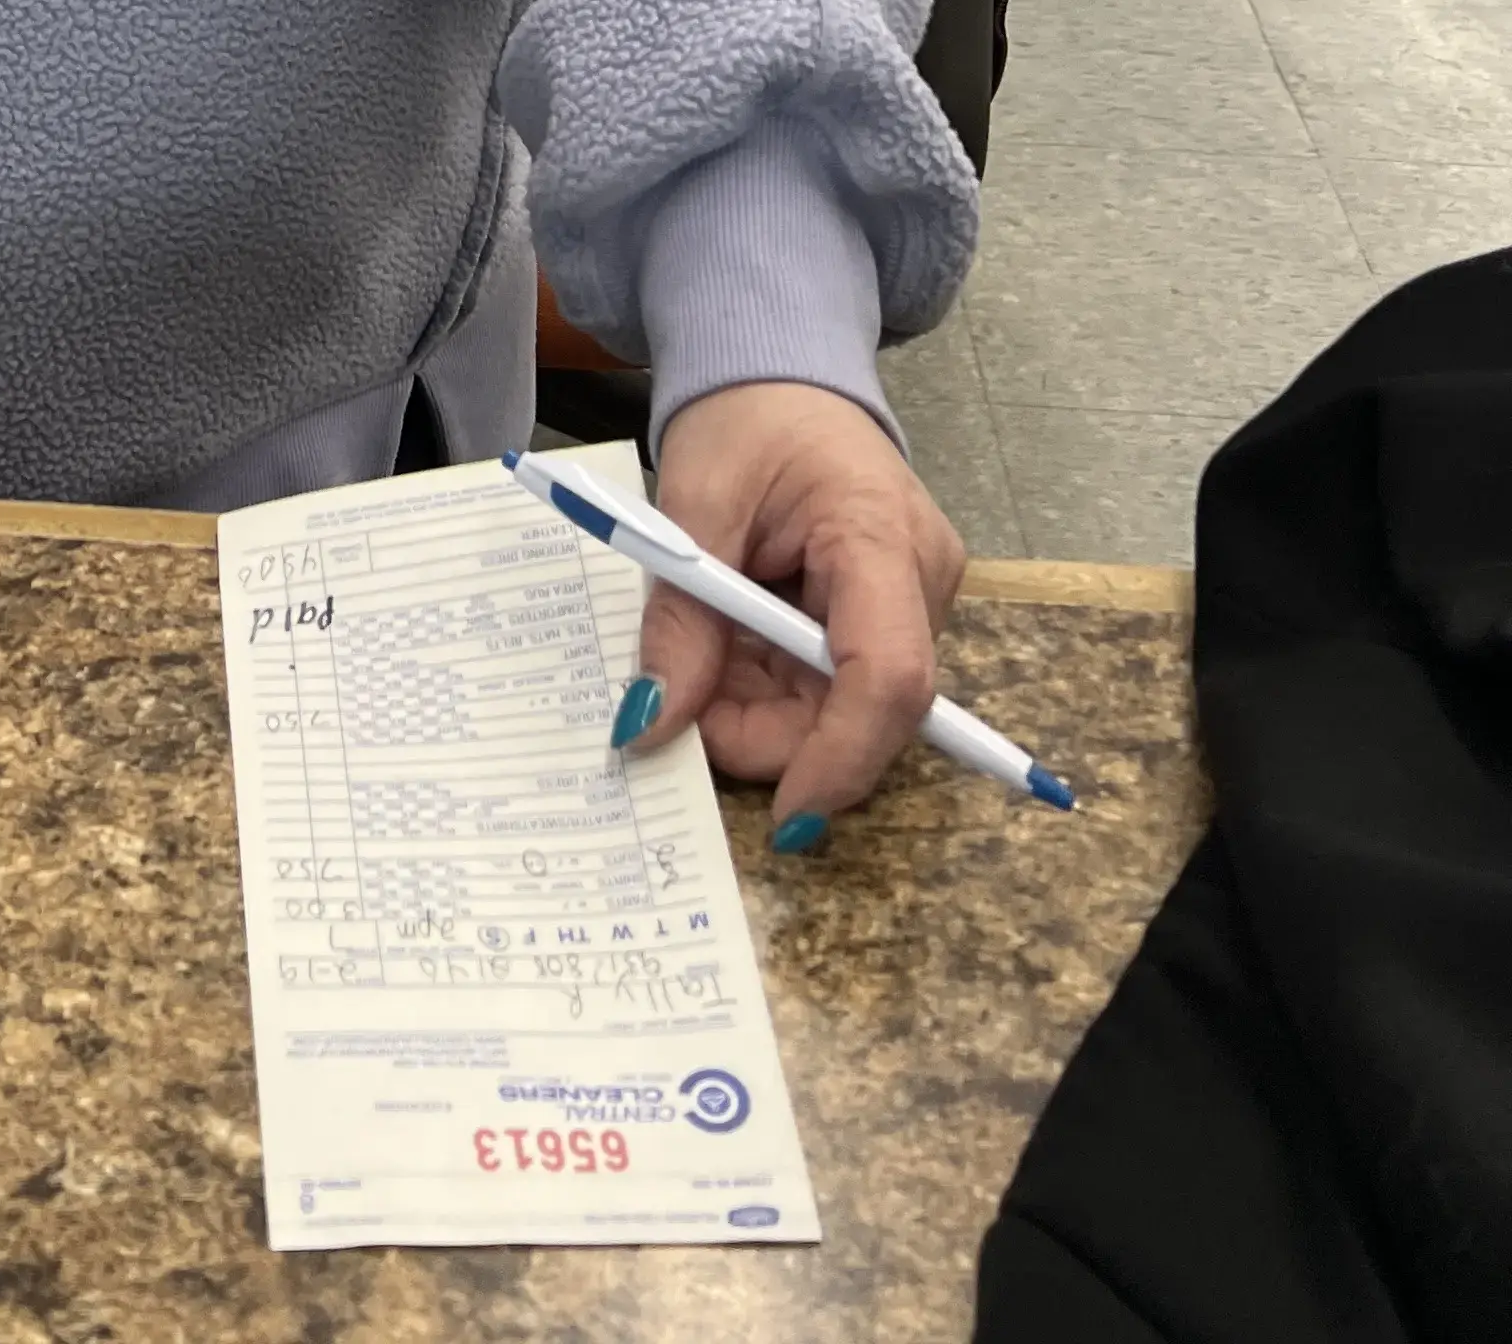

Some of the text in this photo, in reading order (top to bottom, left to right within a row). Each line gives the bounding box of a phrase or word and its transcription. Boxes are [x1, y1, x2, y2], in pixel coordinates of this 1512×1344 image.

[655, 918, 669, 937] T
[688, 913, 710, 931] M
[557, 926, 591, 945] TH
[612, 924, 634, 941] W
[498, 1085, 665, 1103] CLEANERS
[562, 1105, 676, 1123] CENTRAL
[473, 1127, 630, 1173] 65613
